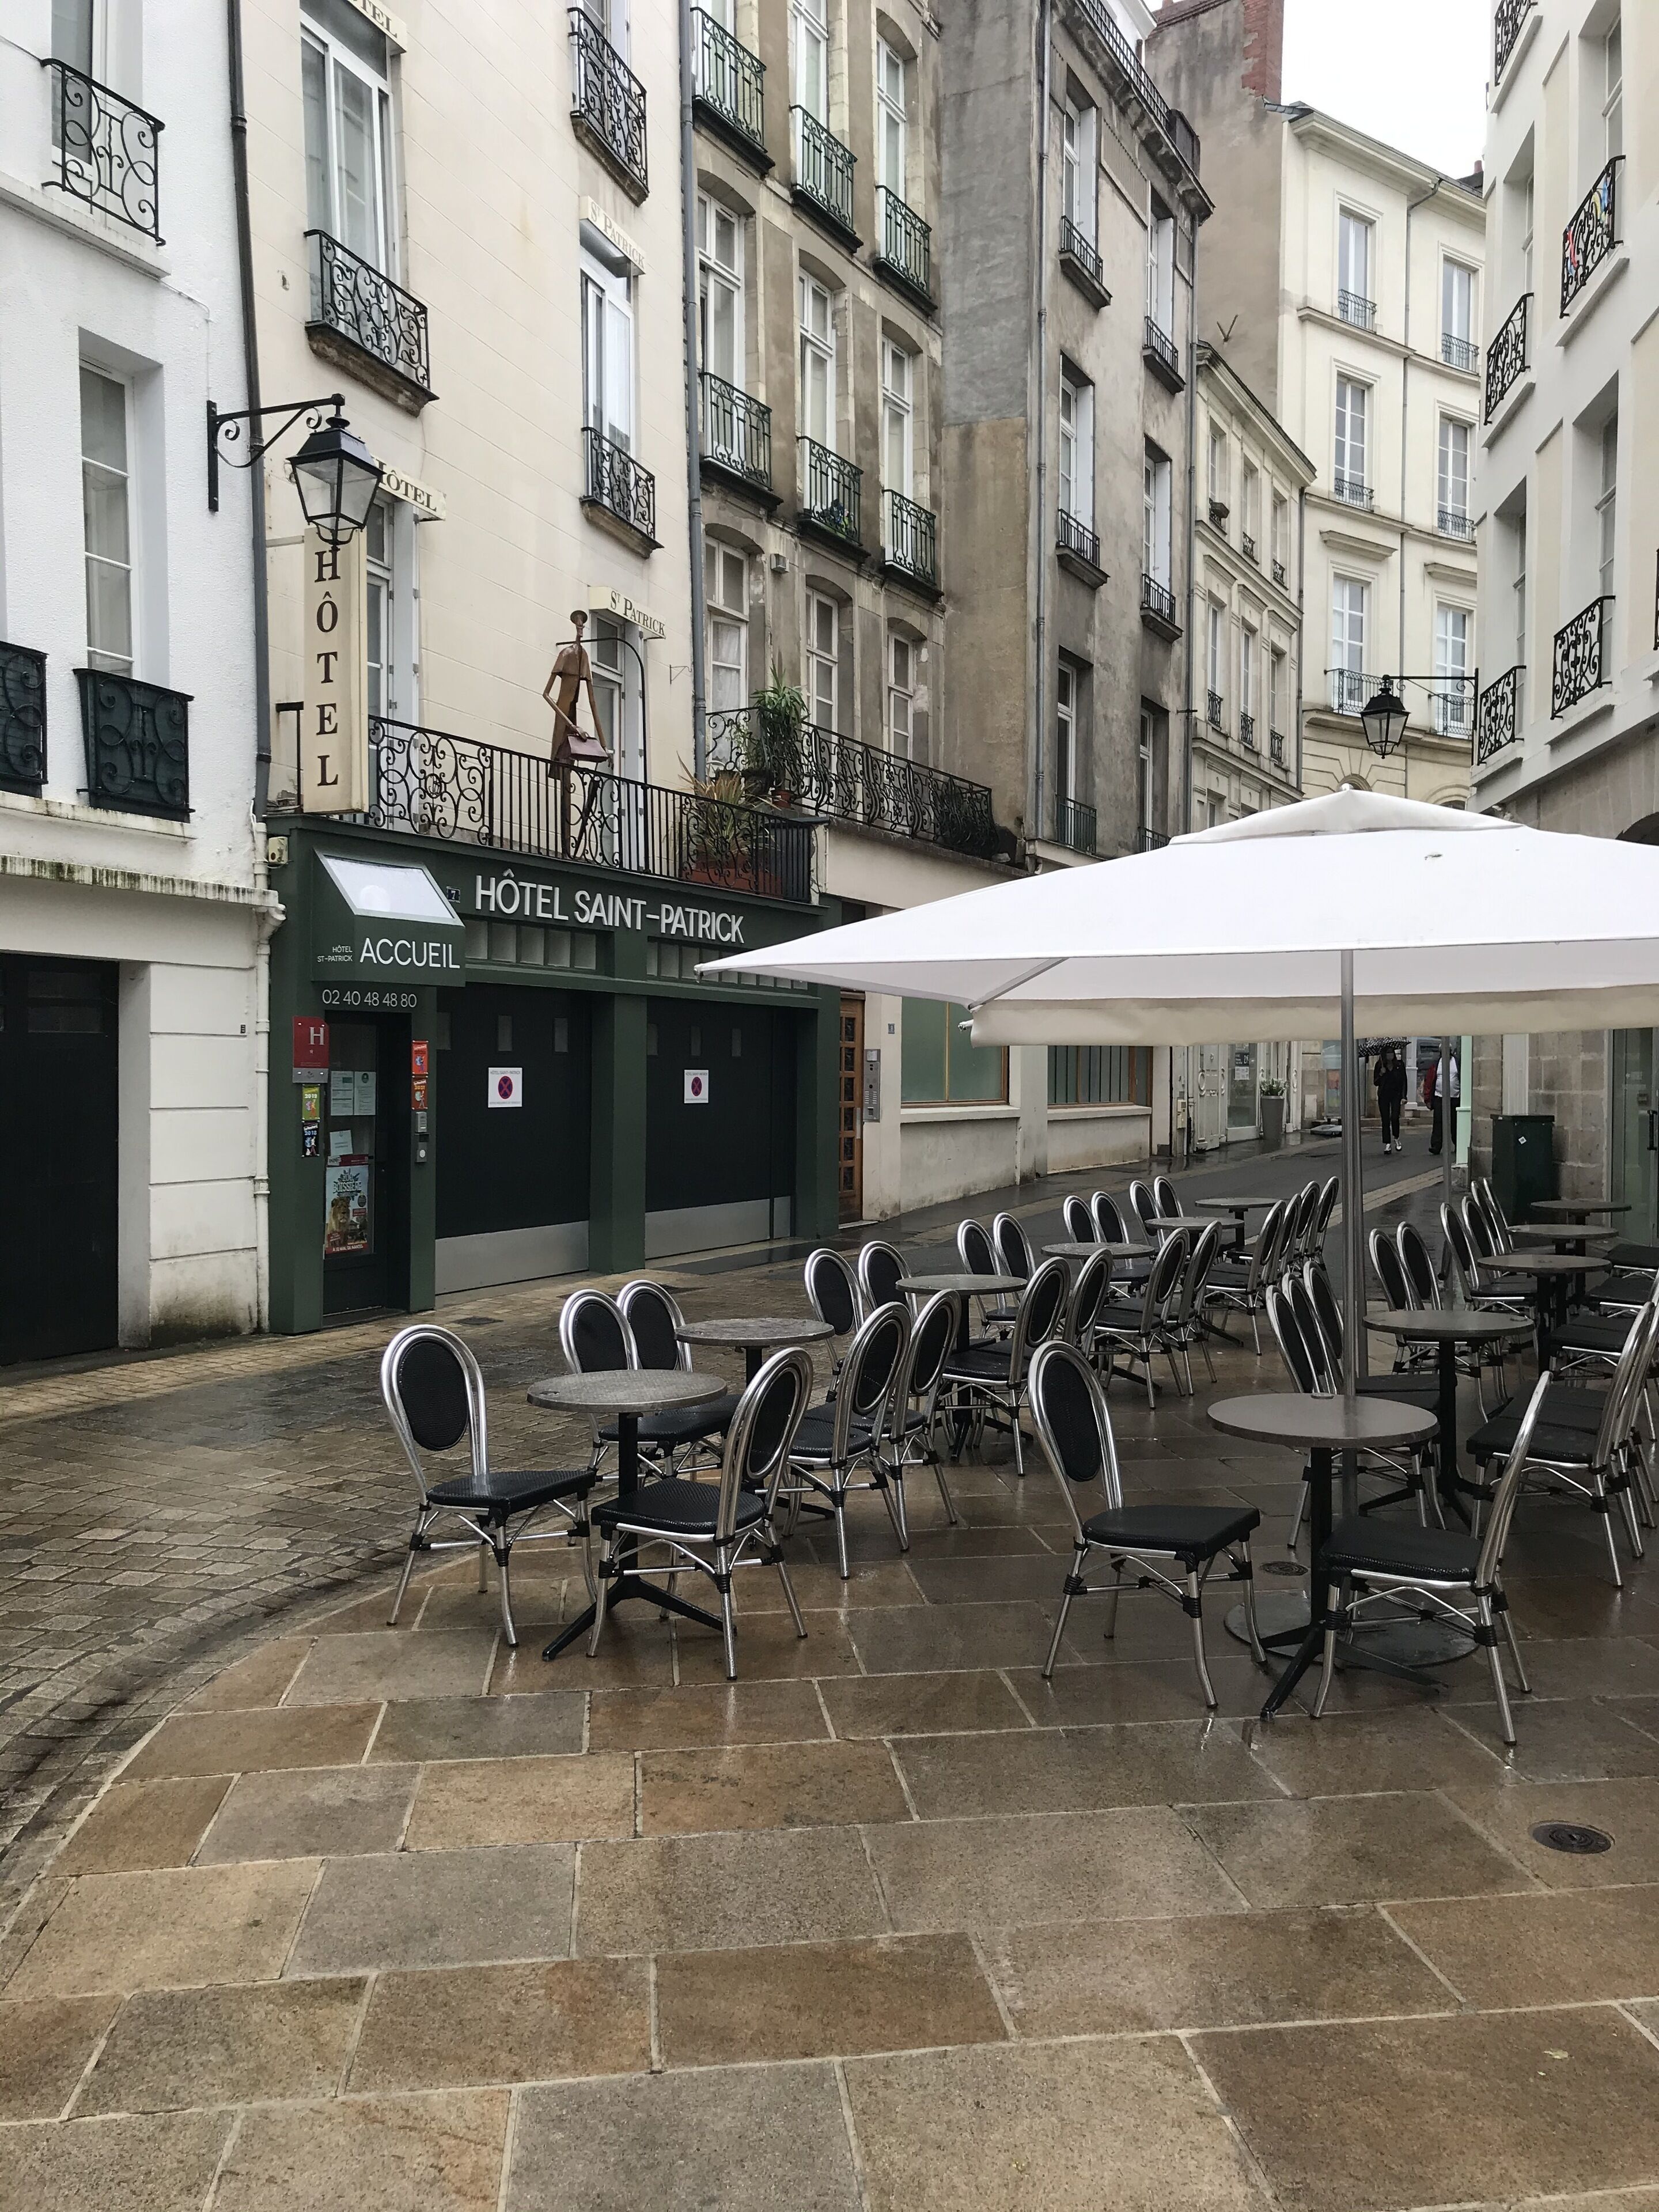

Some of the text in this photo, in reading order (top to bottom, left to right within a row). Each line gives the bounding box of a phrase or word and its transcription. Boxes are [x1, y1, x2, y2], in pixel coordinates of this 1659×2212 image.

[353, 0, 397, 39] TEL
[603, 213, 645, 269] PATRICK
[623, 597, 665, 636] PATRICK
[314, 548, 341, 786] HÔTEL
[451, 890, 456, 900] 7
[475, 868, 745, 944] HÔTEL SAINT-PATRICK
[317, 955, 353, 963] ST-PATRICK
[332, 945, 353, 953] HÔTEL
[360, 937, 460, 969] ACCUEIL
[322, 989, 417, 1008] 02 40 48 48 80
[309, 1027, 324, 1046] H
